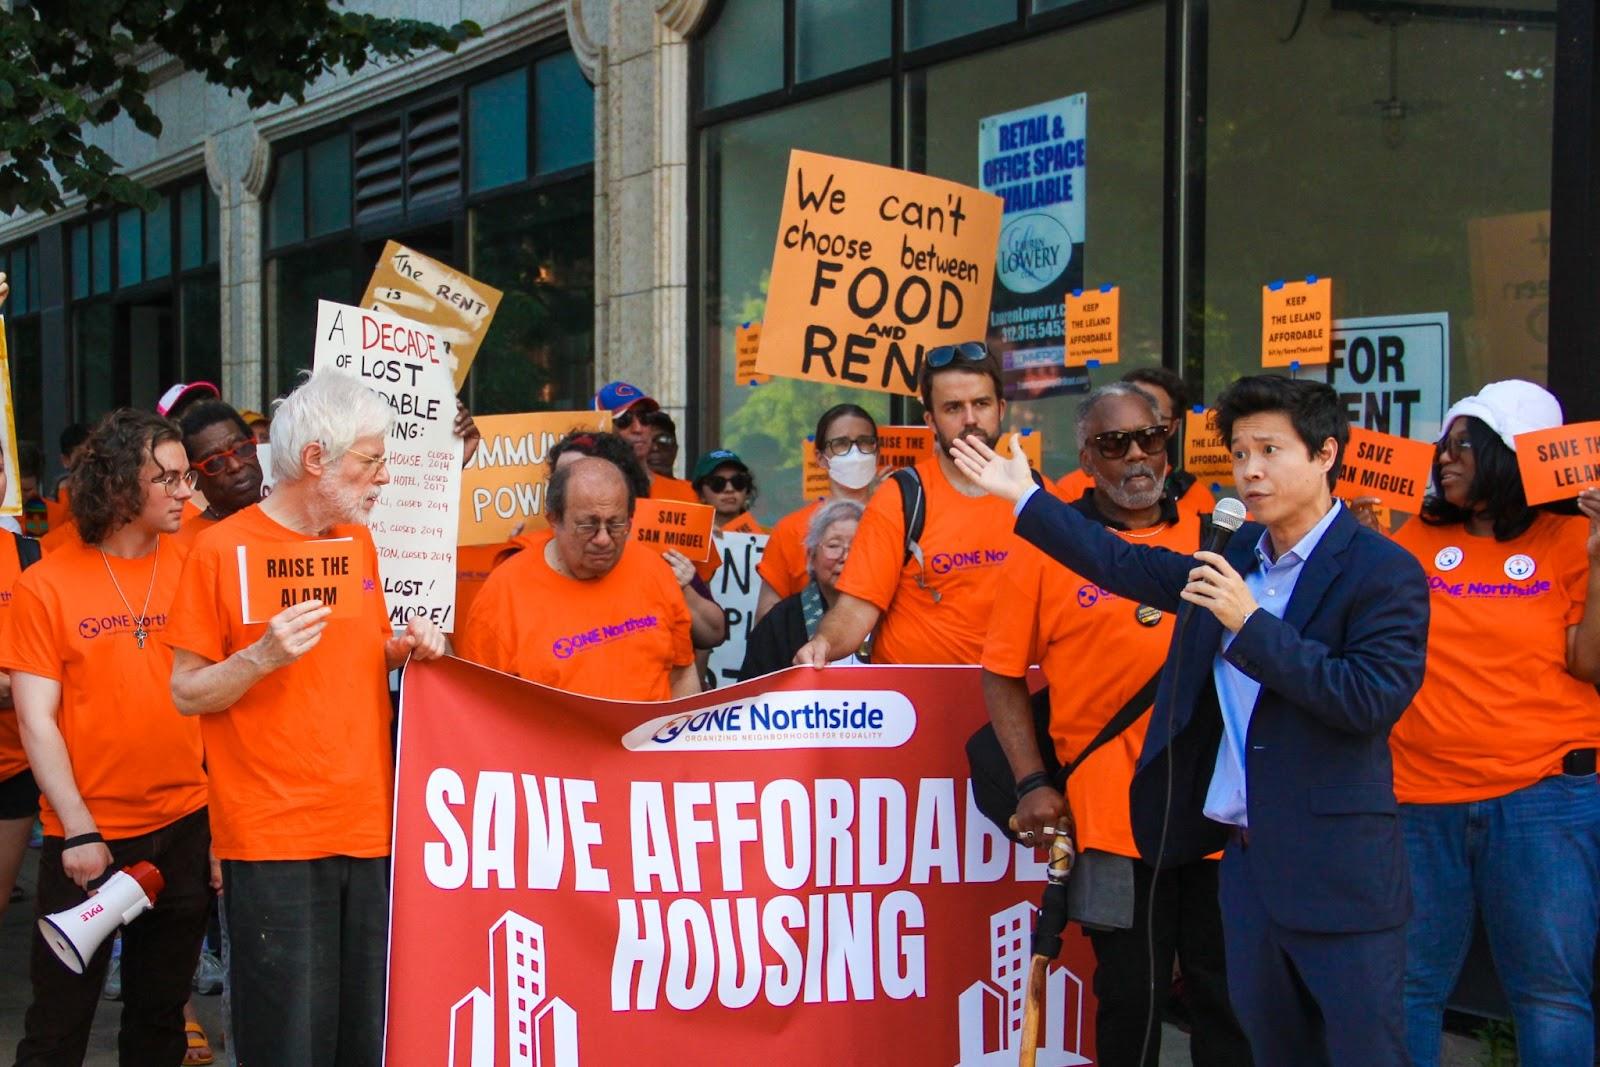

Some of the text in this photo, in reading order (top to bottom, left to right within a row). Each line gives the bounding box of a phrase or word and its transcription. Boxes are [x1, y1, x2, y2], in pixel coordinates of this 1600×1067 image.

[999, 114, 1064, 152] RETAIL &
[983, 138, 1085, 187] OFFICE SPACE
[798, 167, 966, 236] We can't
[784, 220, 978, 284] choose between
[1002, 245, 1060, 274] LOWERY
[386, 288, 401, 300] is
[394, 254, 487, 316] The RENT
[810, 259, 964, 330] FOOD
[1082, 303, 1099, 312] KEEP
[1286, 296, 1306, 306] KEEP
[1072, 317, 1110, 328] THE LELAND
[1272, 312, 1321, 325] THE LELAND
[328, 310, 440, 364] A DECADE
[865, 322, 906, 341] AND
[1070, 332, 1112, 344] AFFORDABLE
[1269, 329, 1323, 342] AFFORDABLE
[802, 324, 924, 392] REN
[1326, 336, 1405, 384] FOR
[336, 354, 424, 386] OF LOST
[1340, 390, 1420, 439] ENT
[879, 436, 924, 449] AISE THE
[1192, 439, 1205, 448] THE
[1537, 436, 1600, 462] SAVE TH
[428, 450, 454, 460] CLOSED
[1189, 455, 1232, 464] AFFORDABL
[1357, 442, 1394, 464] SAVE
[428, 460, 449, 470] 2014
[423, 474, 448, 482] CLOSED
[1339, 464, 1415, 496] AN MIGUEL
[1554, 464, 1600, 488] LELAN
[428, 500, 448, 512] 2019
[473, 482, 549, 522] POW
[658, 510, 687, 526] SAVE
[390, 524, 416, 534] CLOSED
[420, 526, 443, 538] 2019
[638, 528, 703, 548] SAN MIGUEL
[402, 551, 427, 559] CLOSED
[431, 551, 452, 562] 2019
[953, 552, 981, 566] ONE
[267, 556, 349, 578] RAISE THE
[1429, 576, 1550, 596] ONE Northside
[101, 616, 130, 630] ONE
[572, 628, 602, 648] ONE
[602, 616, 657, 638] Northside
[688, 702, 883, 732] ONE Northside
[684, 734, 738, 743] ORGANIZING
[742, 732, 820, 741] NEIGHBORHOODS
[424, 767, 1048, 892] SAVE AFFORDABL
[611, 890, 926, 1011] HOUSING
